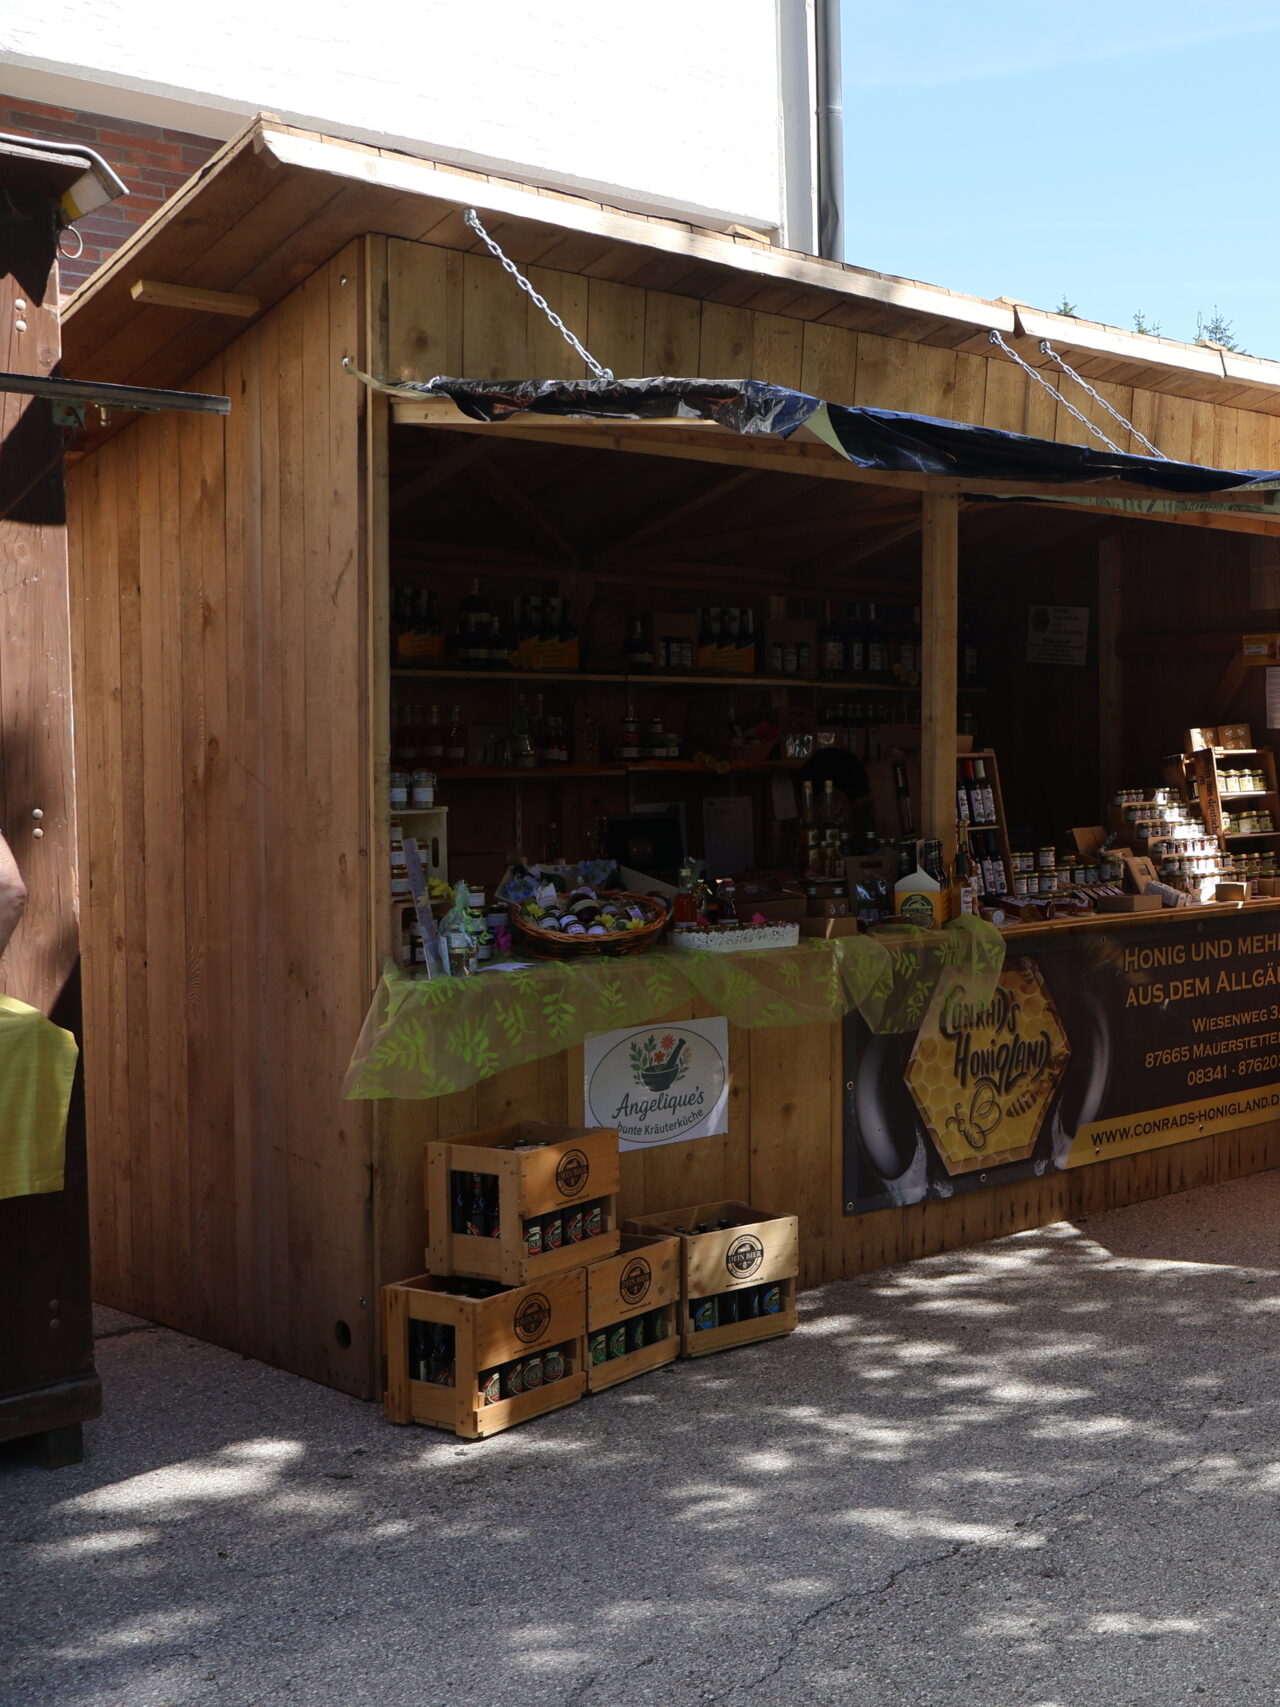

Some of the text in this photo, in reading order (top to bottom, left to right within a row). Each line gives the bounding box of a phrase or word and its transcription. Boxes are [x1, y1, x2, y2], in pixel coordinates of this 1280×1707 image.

[1124, 944, 1186, 972] HONIG
[1191, 938, 1232, 964] UND
[1125, 986, 1165, 1009] AUS
[1169, 980, 1211, 1003] DEM
[1192, 1009, 1268, 1034] WIESENWEG
[1145, 1046, 1190, 1069] 87665
[1187, 1065, 1228, 1087] 08341
[612, 1086, 704, 1121] Angelique's
[645, 1108, 704, 1136] Kräuterküche
[727, 1250, 762, 1263] DEIN BIER
